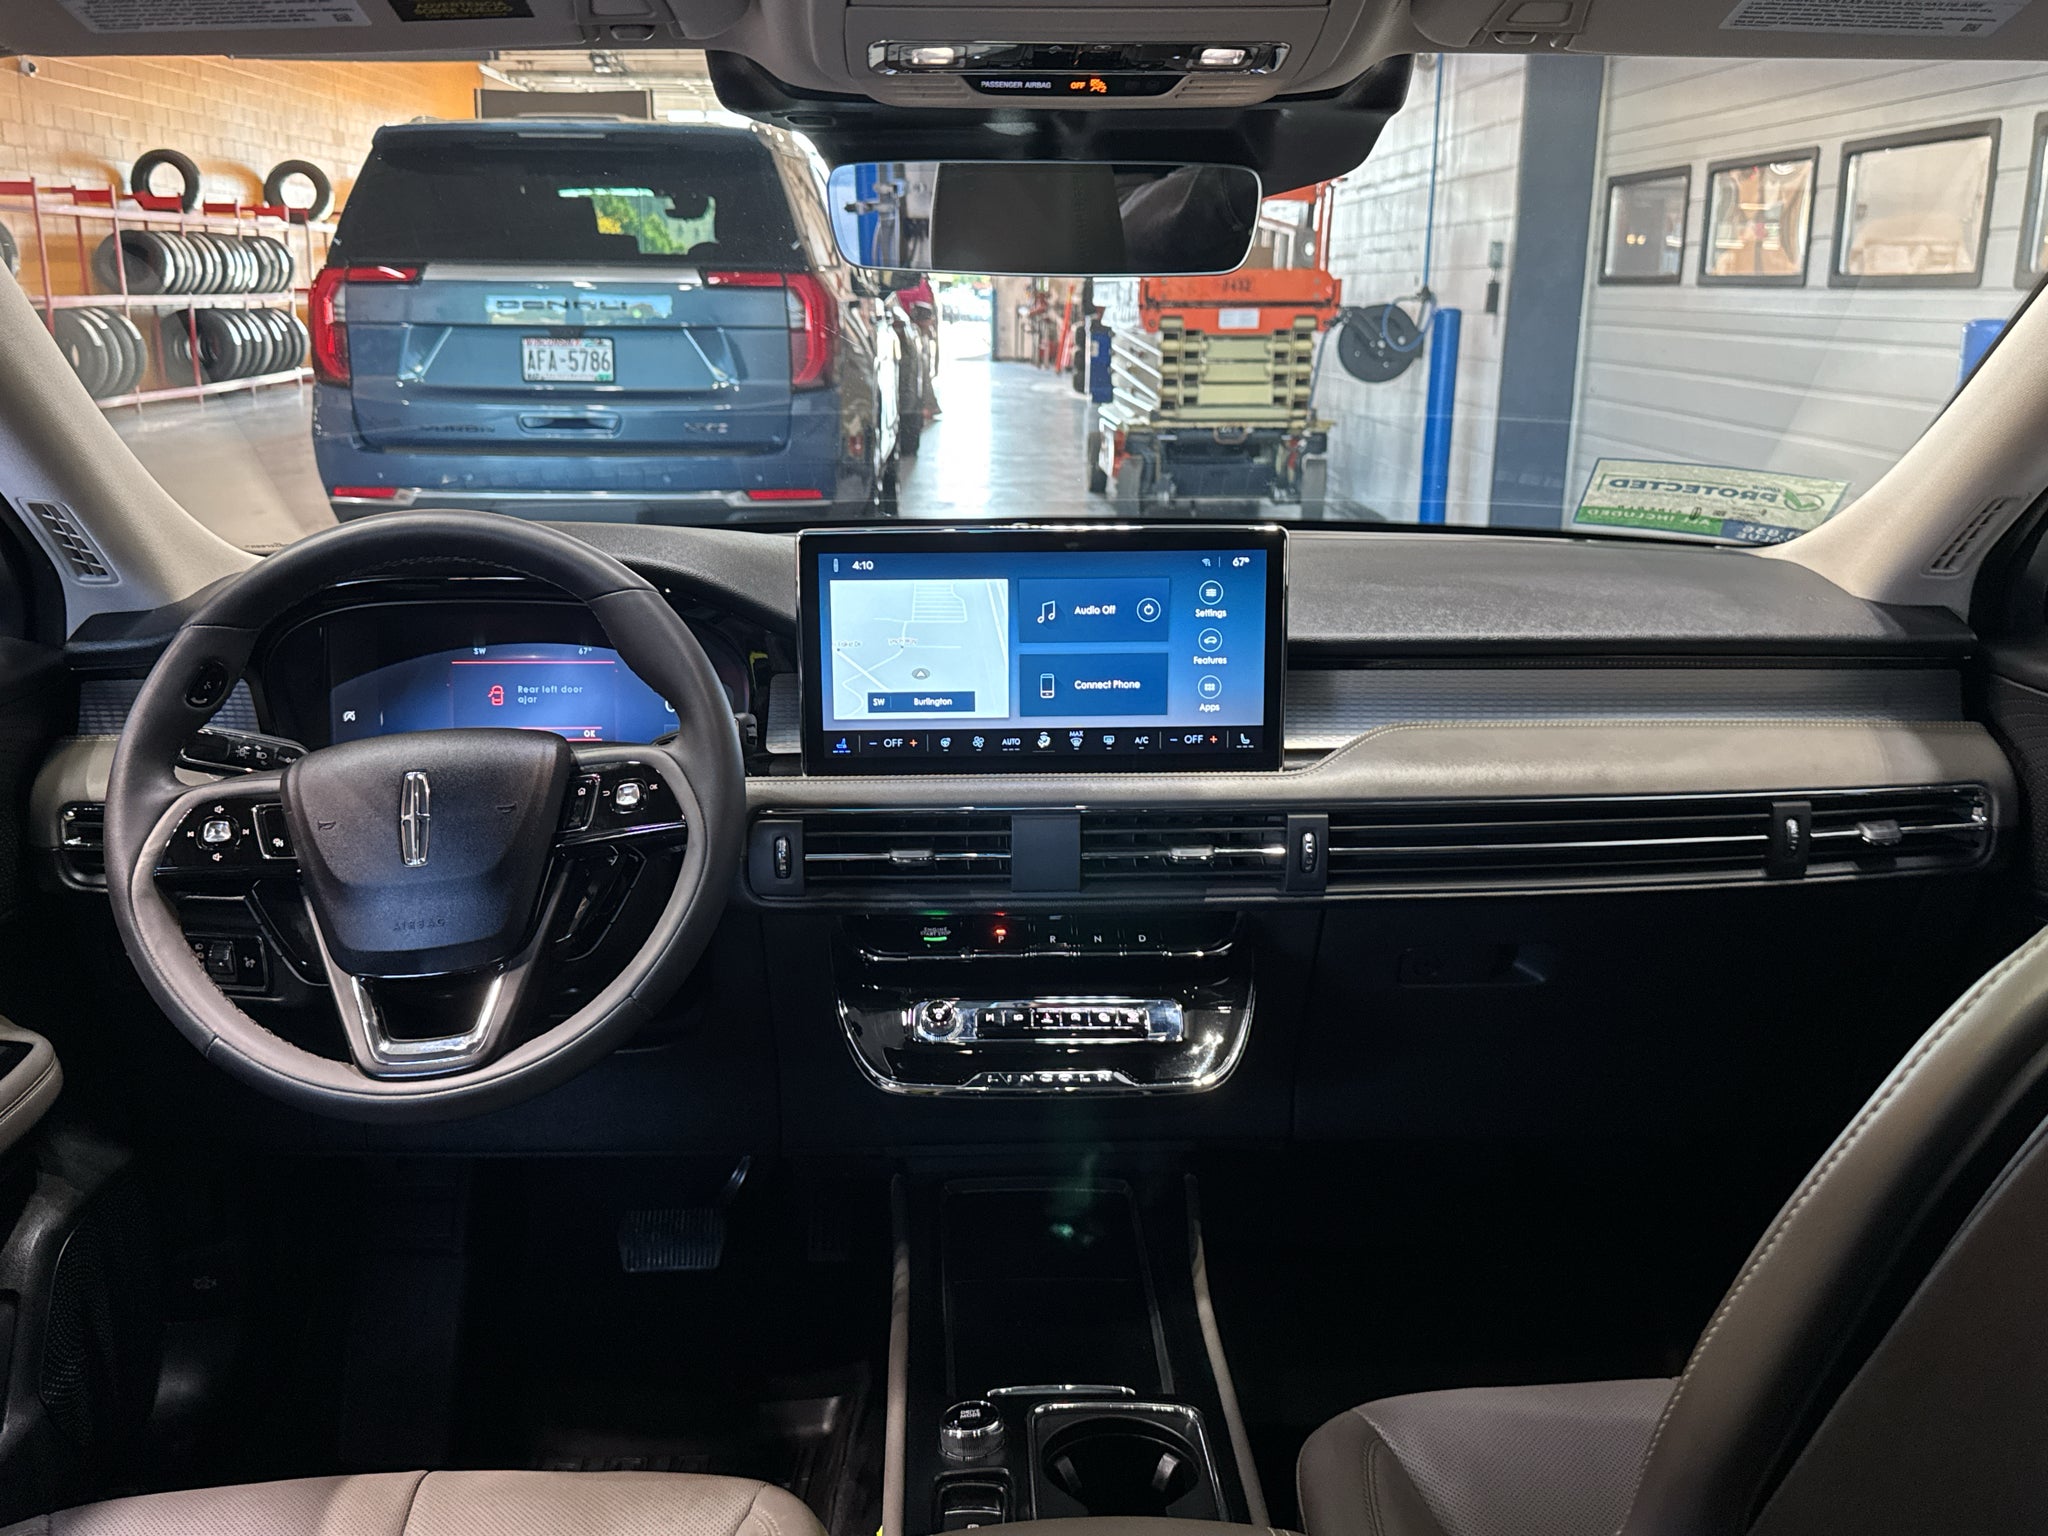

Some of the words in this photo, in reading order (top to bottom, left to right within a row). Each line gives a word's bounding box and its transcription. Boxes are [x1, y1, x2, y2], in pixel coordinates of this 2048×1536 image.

[980, 80, 1023, 89] PASSENGER
[1024, 81, 1052, 89] AIRBAG
[1070, 81, 1086, 90] OFF
[496, 300, 627, 310] DENALI
[527, 349, 611, 372] AFA-5786
[852, 560, 874, 571] 4:10
[1232, 557, 1250, 567] 67°
[1074, 605, 1101, 615] Audio
[1102, 604, 1116, 615] Off
[1195, 608, 1228, 619] Settings
[473, 647, 487, 656] SW
[578, 647, 593, 656] 67°
[1193, 656, 1228, 665] Features
[517, 684, 539, 694] Rear
[542, 684, 558, 694] left
[561, 684, 583, 694] door
[1074, 679, 1112, 690] Connect
[1113, 679, 1141, 690] Phone
[517, 695, 537, 705] ajar
[872, 698, 885, 707] SW
[913, 697, 953, 707] Burlington
[1199, 703, 1221, 713] Apps
[583, 729, 596, 738] OK
[1069, 730, 1084, 738] MAX
[883, 738, 903, 748] OFF
[1002, 738, 1021, 746] AUTO
[1134, 736, 1149, 744] A/C
[1183, 734, 1204, 744] OFF
[998, 935, 1005, 944] P
[1049, 935, 1057, 944] R
[1093, 935, 1102, 943] N
[1138, 934, 1147, 943] D
